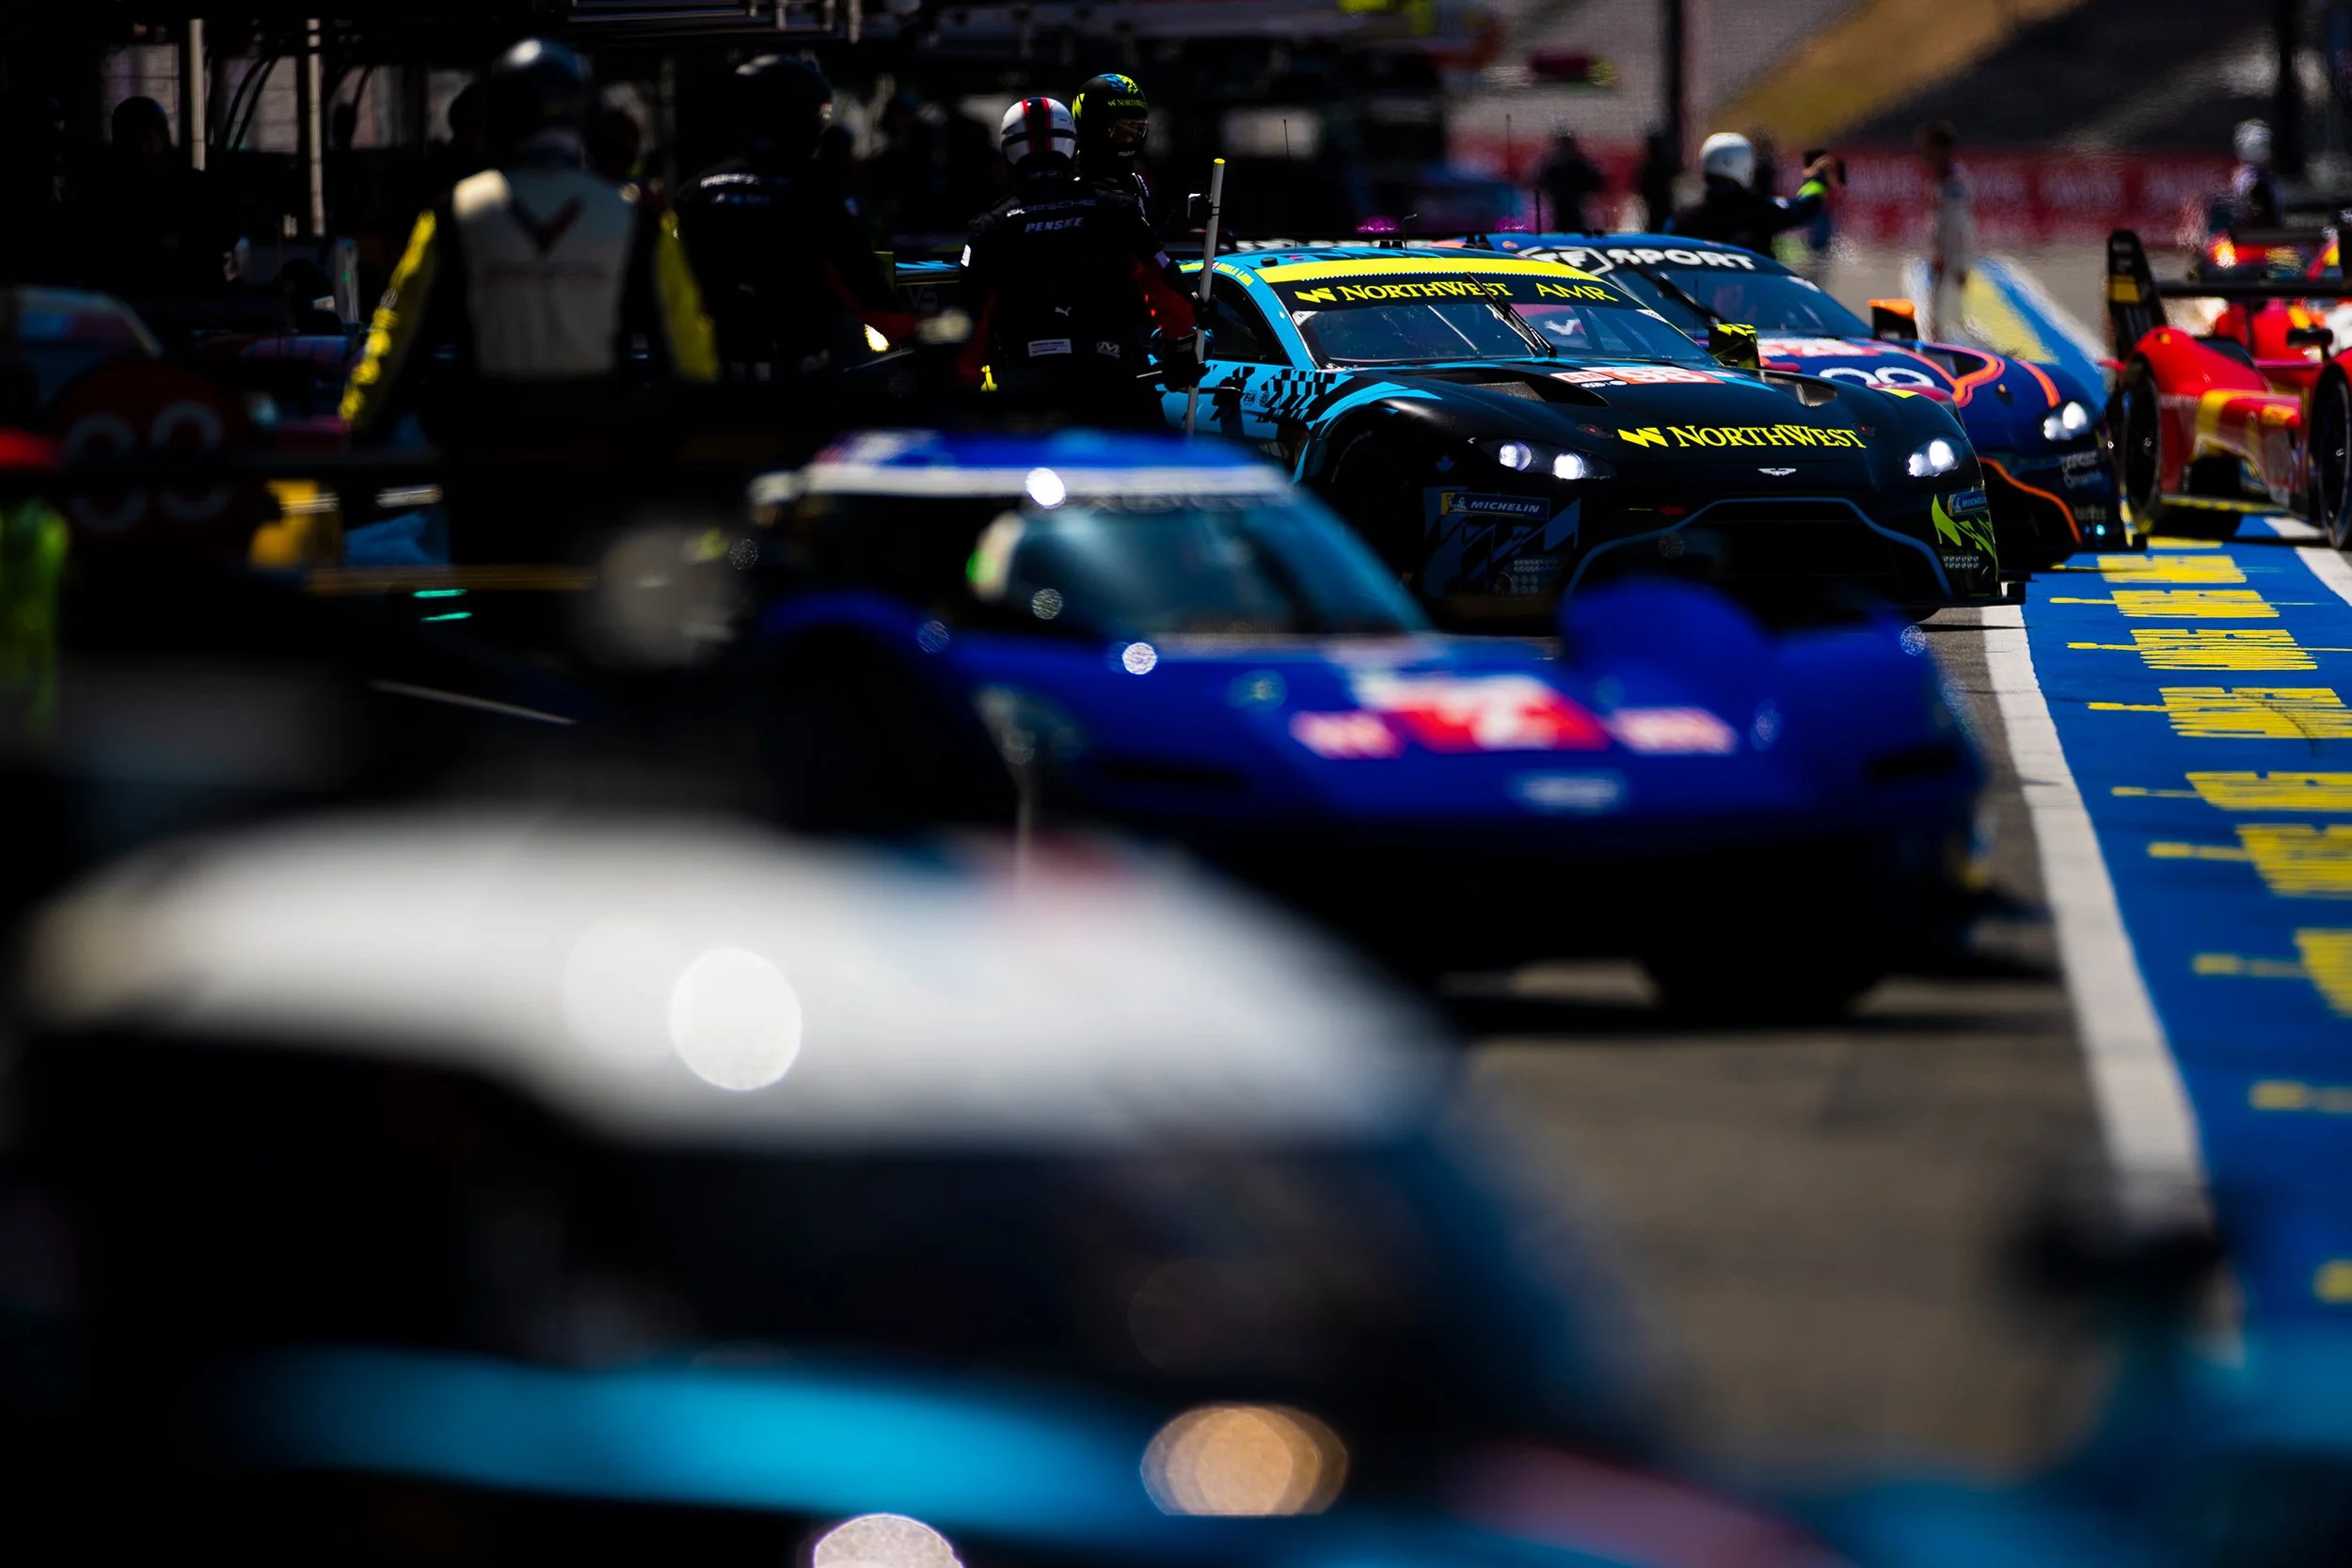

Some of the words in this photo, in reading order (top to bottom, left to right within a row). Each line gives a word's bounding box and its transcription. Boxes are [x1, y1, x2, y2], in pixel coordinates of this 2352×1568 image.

[1024, 216, 1087, 234] PENSKE
[1606, 248, 1756, 271] SPORT
[1337, 281, 1514, 301] NORTHWEST
[1535, 282, 1619, 302] AMR
[1613, 370, 1708, 384] 98
[1666, 424, 1867, 449] NORTHWEST
[1470, 500, 1541, 514] MICHELIN
